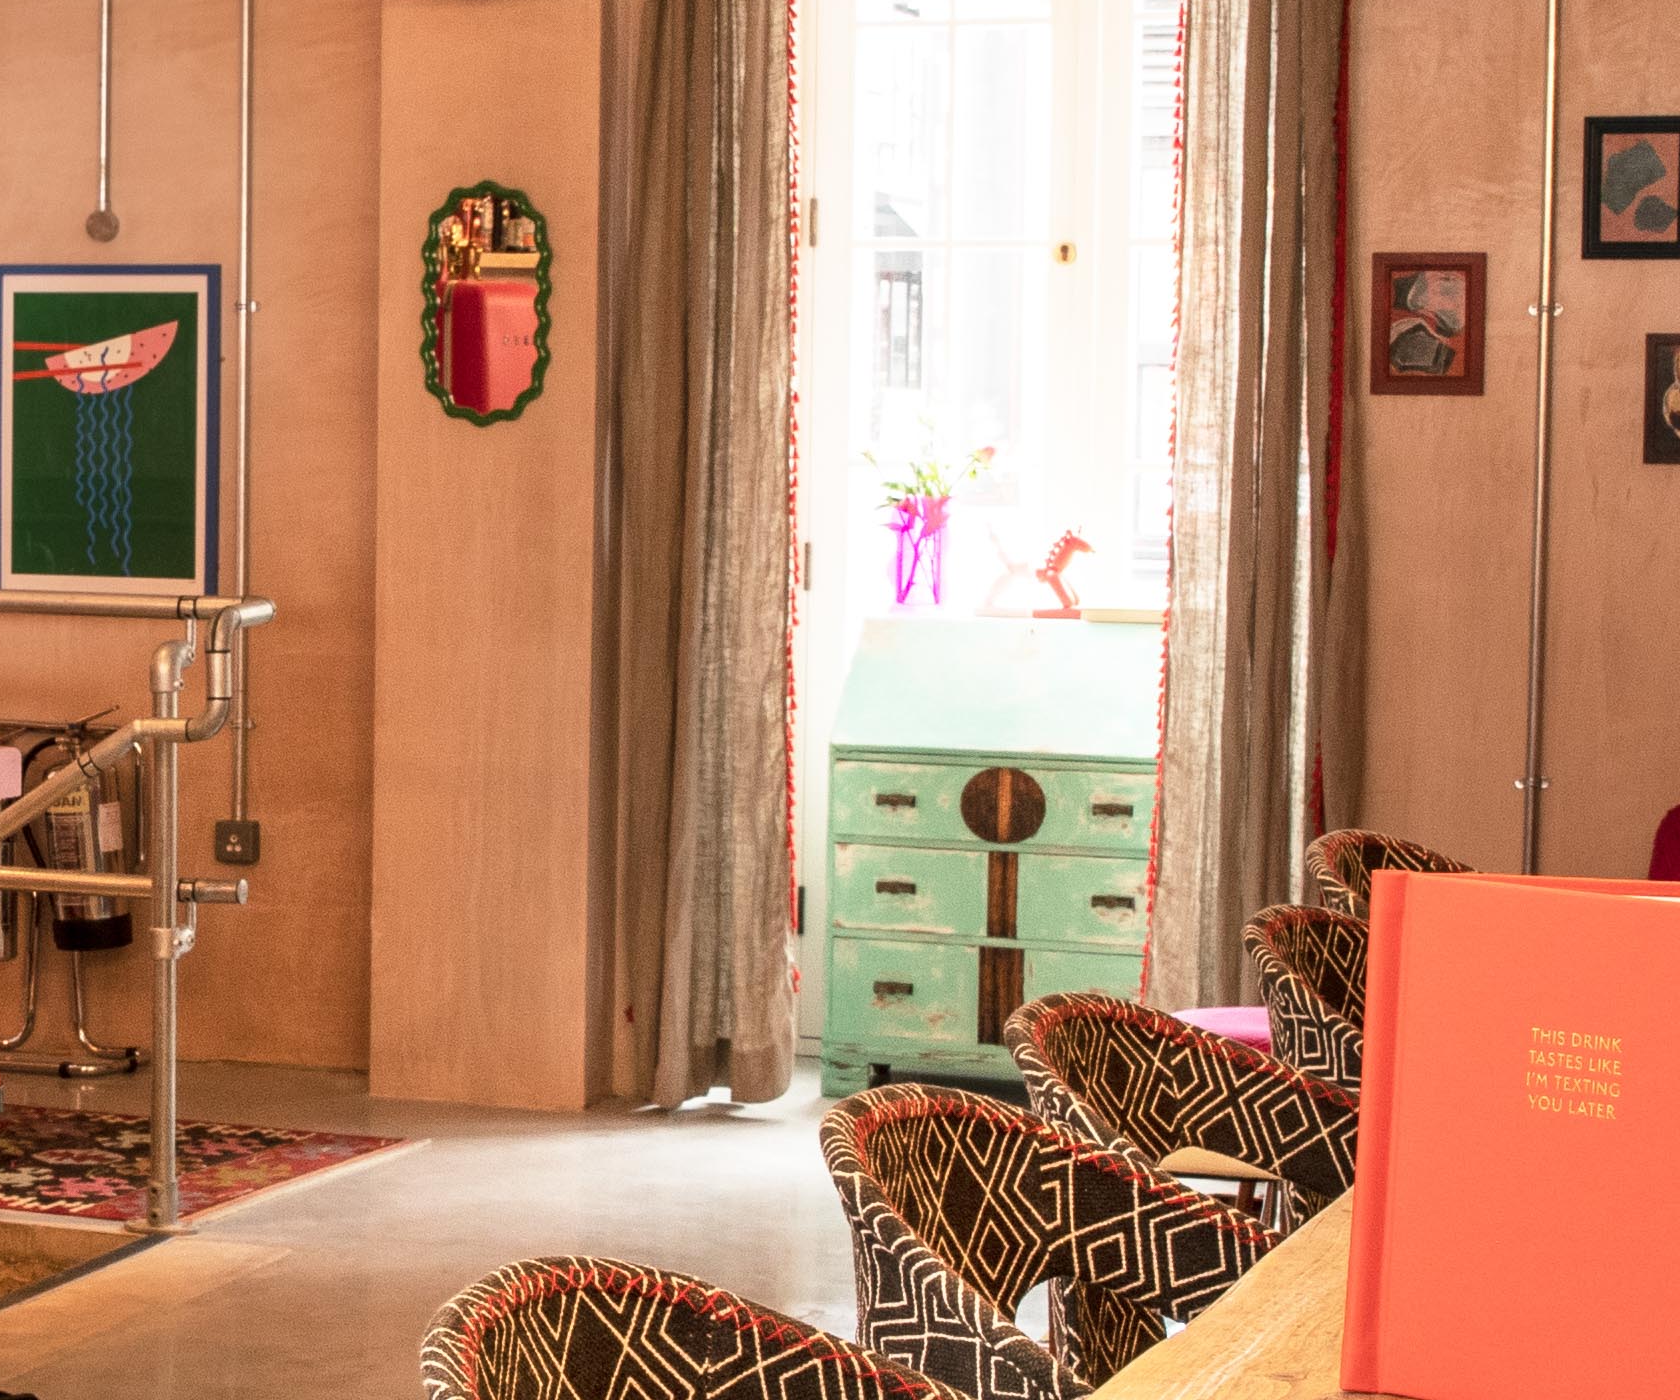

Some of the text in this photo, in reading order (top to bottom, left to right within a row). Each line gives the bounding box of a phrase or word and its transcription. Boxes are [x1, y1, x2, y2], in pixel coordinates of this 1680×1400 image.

[1531, 1027, 1622, 1053] THIS DRINK
[1529, 1049, 1622, 1076] TASTES LIKE
[1526, 1071, 1621, 1098] I'M TEXTING
[1528, 1094, 1617, 1120] YOU LATER
